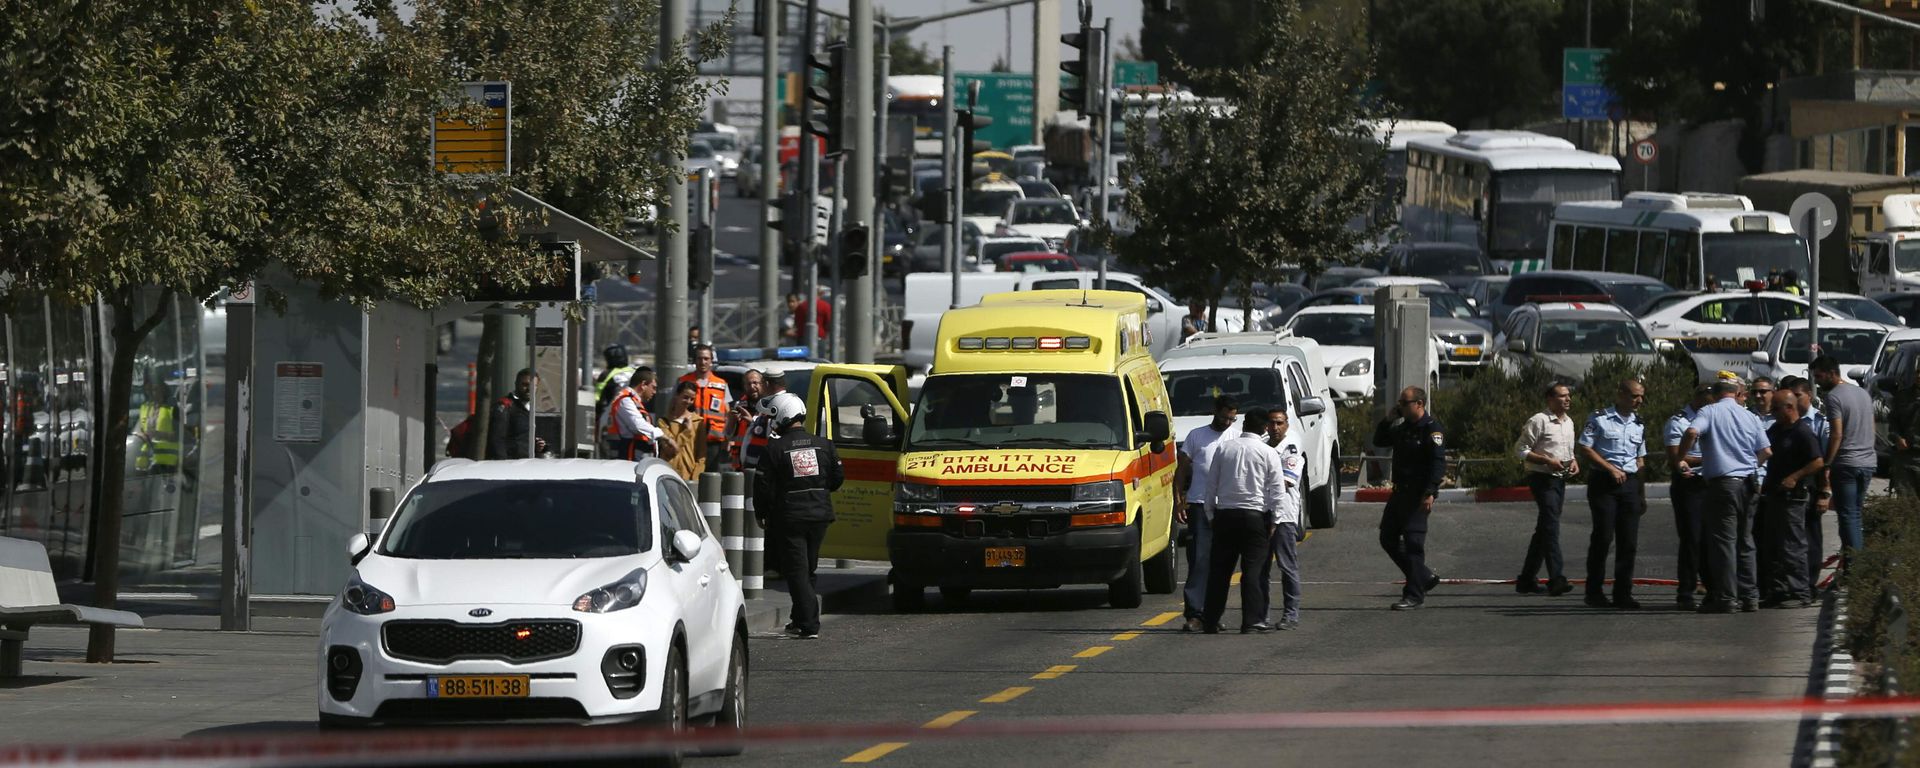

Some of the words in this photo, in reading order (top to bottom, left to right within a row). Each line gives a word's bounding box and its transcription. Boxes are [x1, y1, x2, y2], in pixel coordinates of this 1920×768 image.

[1641, 145, 1653, 156] 70
[1696, 337, 1758, 348] POLICE
[943, 455, 990, 464] אדום
[1000, 454, 1034, 462] דוד
[1044, 455, 1077, 463] מגן
[907, 460, 936, 470] 211
[941, 463, 1075, 475] AMBULANCE
[471, 608, 490, 616] KIA
